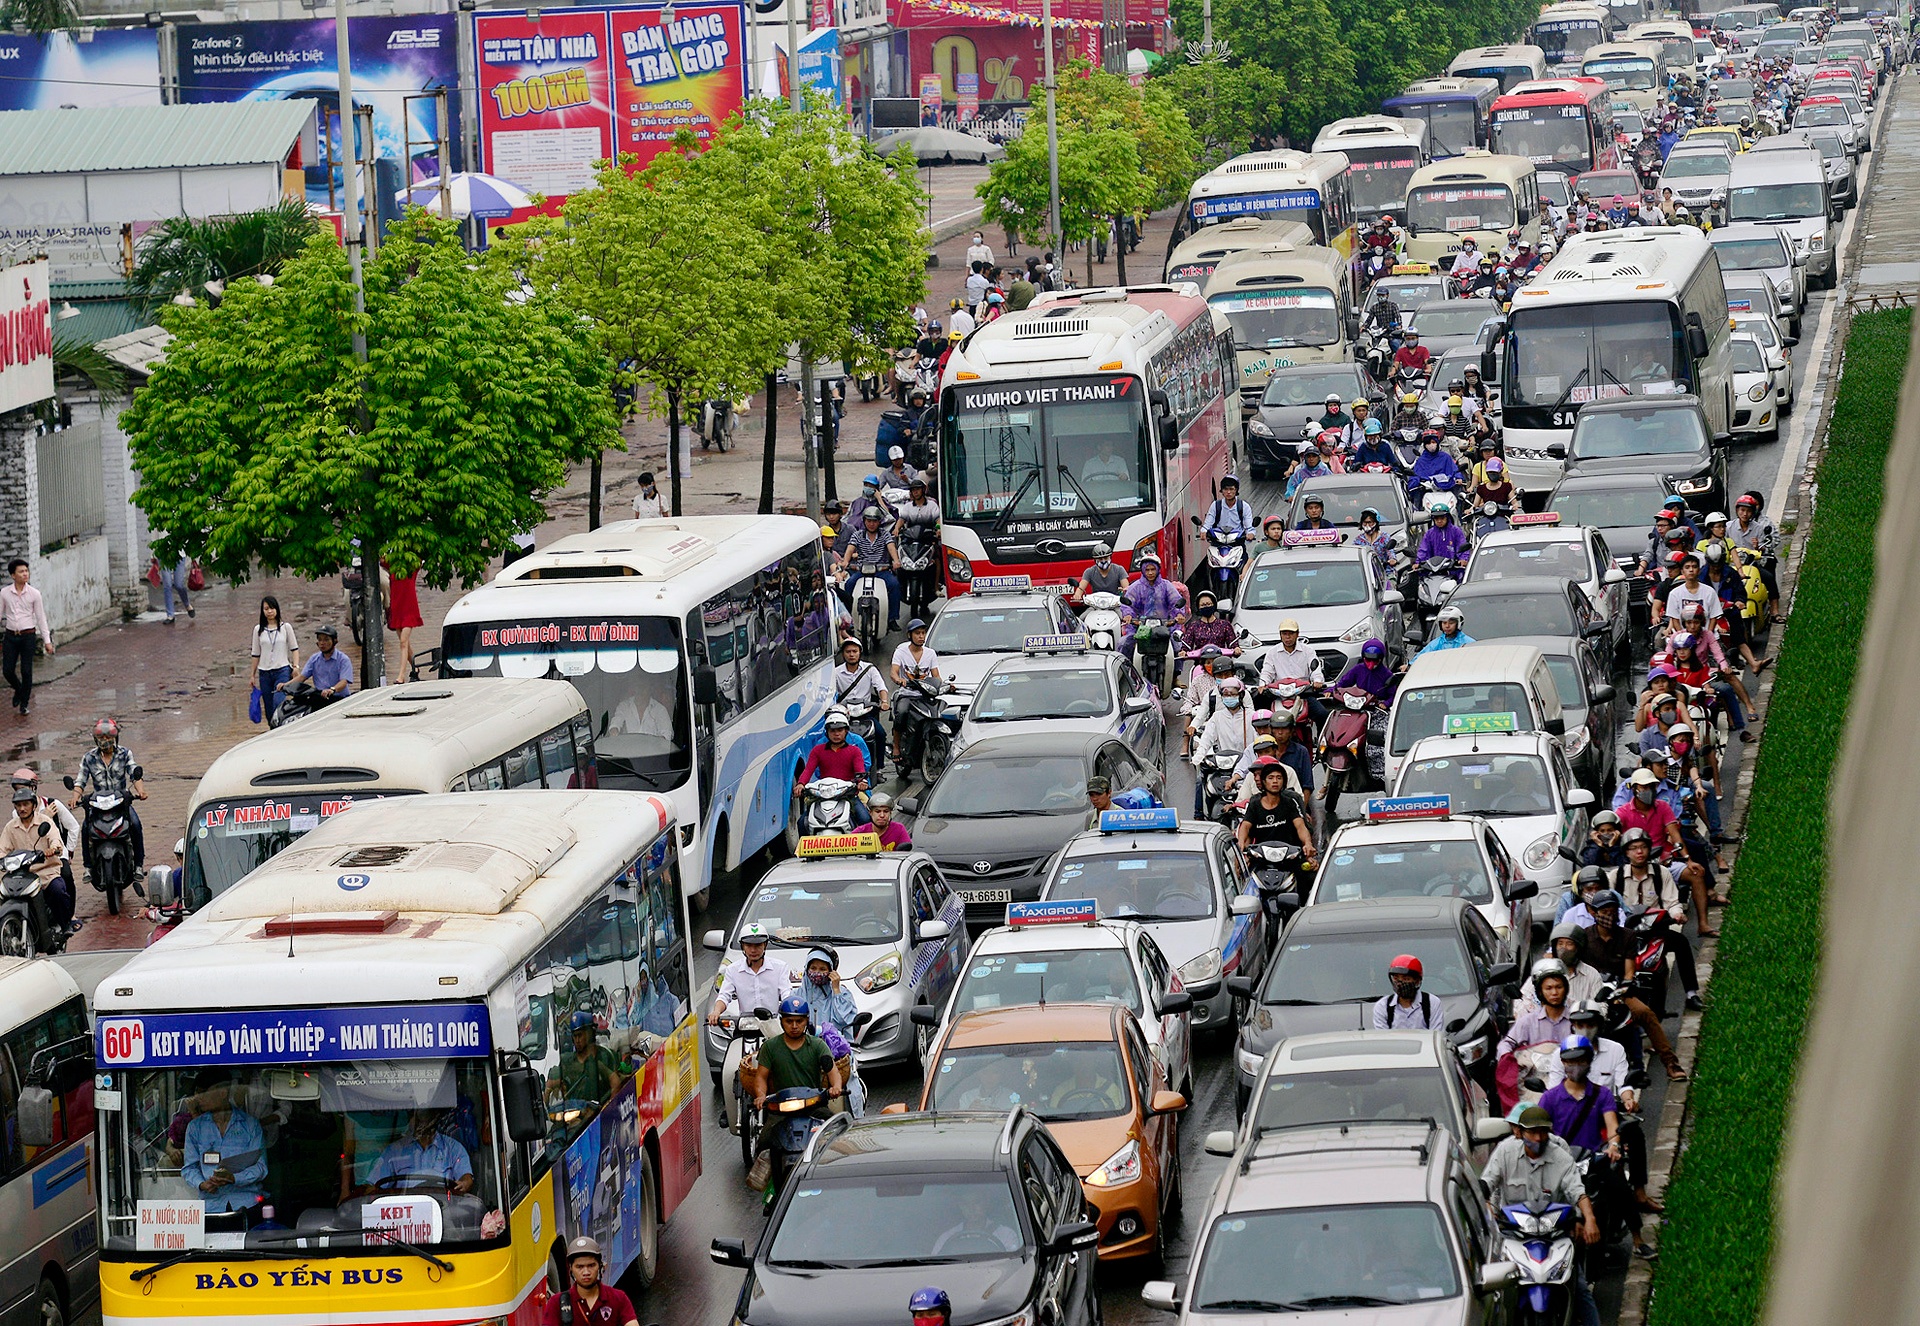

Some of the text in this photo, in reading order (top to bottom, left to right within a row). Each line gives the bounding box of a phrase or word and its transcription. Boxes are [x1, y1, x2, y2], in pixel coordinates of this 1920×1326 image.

[387, 28, 440, 44] ASUS
[621, 13, 725, 55] BÁN HÀNG
[191, 36, 243, 50] Zenfone 2
[521, 33, 598, 64] TẬN NHÀ
[193, 48, 324, 67] Nhìn thấy điều khác biệt
[626, 46, 677, 84] TRẢ
[680, 39, 728, 74] GÓP
[493, 77, 591, 117] 100KM
[672, 98, 693, 111] thấp
[640, 116, 657, 126] Thủ
[658, 116, 672, 127] tục
[672, 115, 691, 125] đơn
[640, 130, 656, 141] Xét
[1312, 197, 1316, 206] 2
[1463, 219, 1478, 228] ĐÌNH
[16, 225, 40, 239] NHÀ
[69, 252, 100, 261] KHU B
[1180, 265, 1204, 277] YÊN
[1245, 299, 1254, 308] XE
[1255, 299, 1271, 308] CHẠY
[1273, 297, 1287, 306] CAO
[1243, 359, 1268, 378] NAM
[965, 384, 1116, 409] KUMHO VIET THANH
[960, 496, 980, 513] MỸ
[1006, 524, 1016, 534] MỸ
[1017, 522, 1032, 533] ĐÌNH
[1035, 520, 1045, 532] BÃI
[1045, 519, 1062, 531] CHÁY
[1079, 516, 1092, 529] PHẢ
[1526, 514, 1545, 522] TAXI
[975, 579, 991, 588] SAO
[992, 577, 1016, 587] HANOI
[481, 620, 640, 647] BX QUỲNH CÔI BX MỸ ĐÌNH
[1027, 637, 1043, 647] SAO
[1045, 635, 1071, 646] HANOI
[1469, 720, 1511, 729] TAXI
[206, 804, 229, 827] LÝ
[234, 799, 292, 824] NHÂN
[1380, 800, 1448, 812] TAXIGROUP
[1108, 813, 1127, 822] BA
[1128, 812, 1155, 821] SAO
[1019, 905, 1094, 917] TAXIGROUP
[105, 1023, 143, 1059] 60A
[151, 1018, 479, 1057] KĐT PHÁP VÂN TỨ HIỆP NAM THĂNG LONG
[142, 1209, 154, 1225] BX.
[155, 1204, 176, 1225] NƯỚC
[381, 1206, 413, 1220] KĐT
[153, 1230, 185, 1250] MỸ ĐÌNH
[195, 1263, 404, 1290] BẢO YẾN BUS
